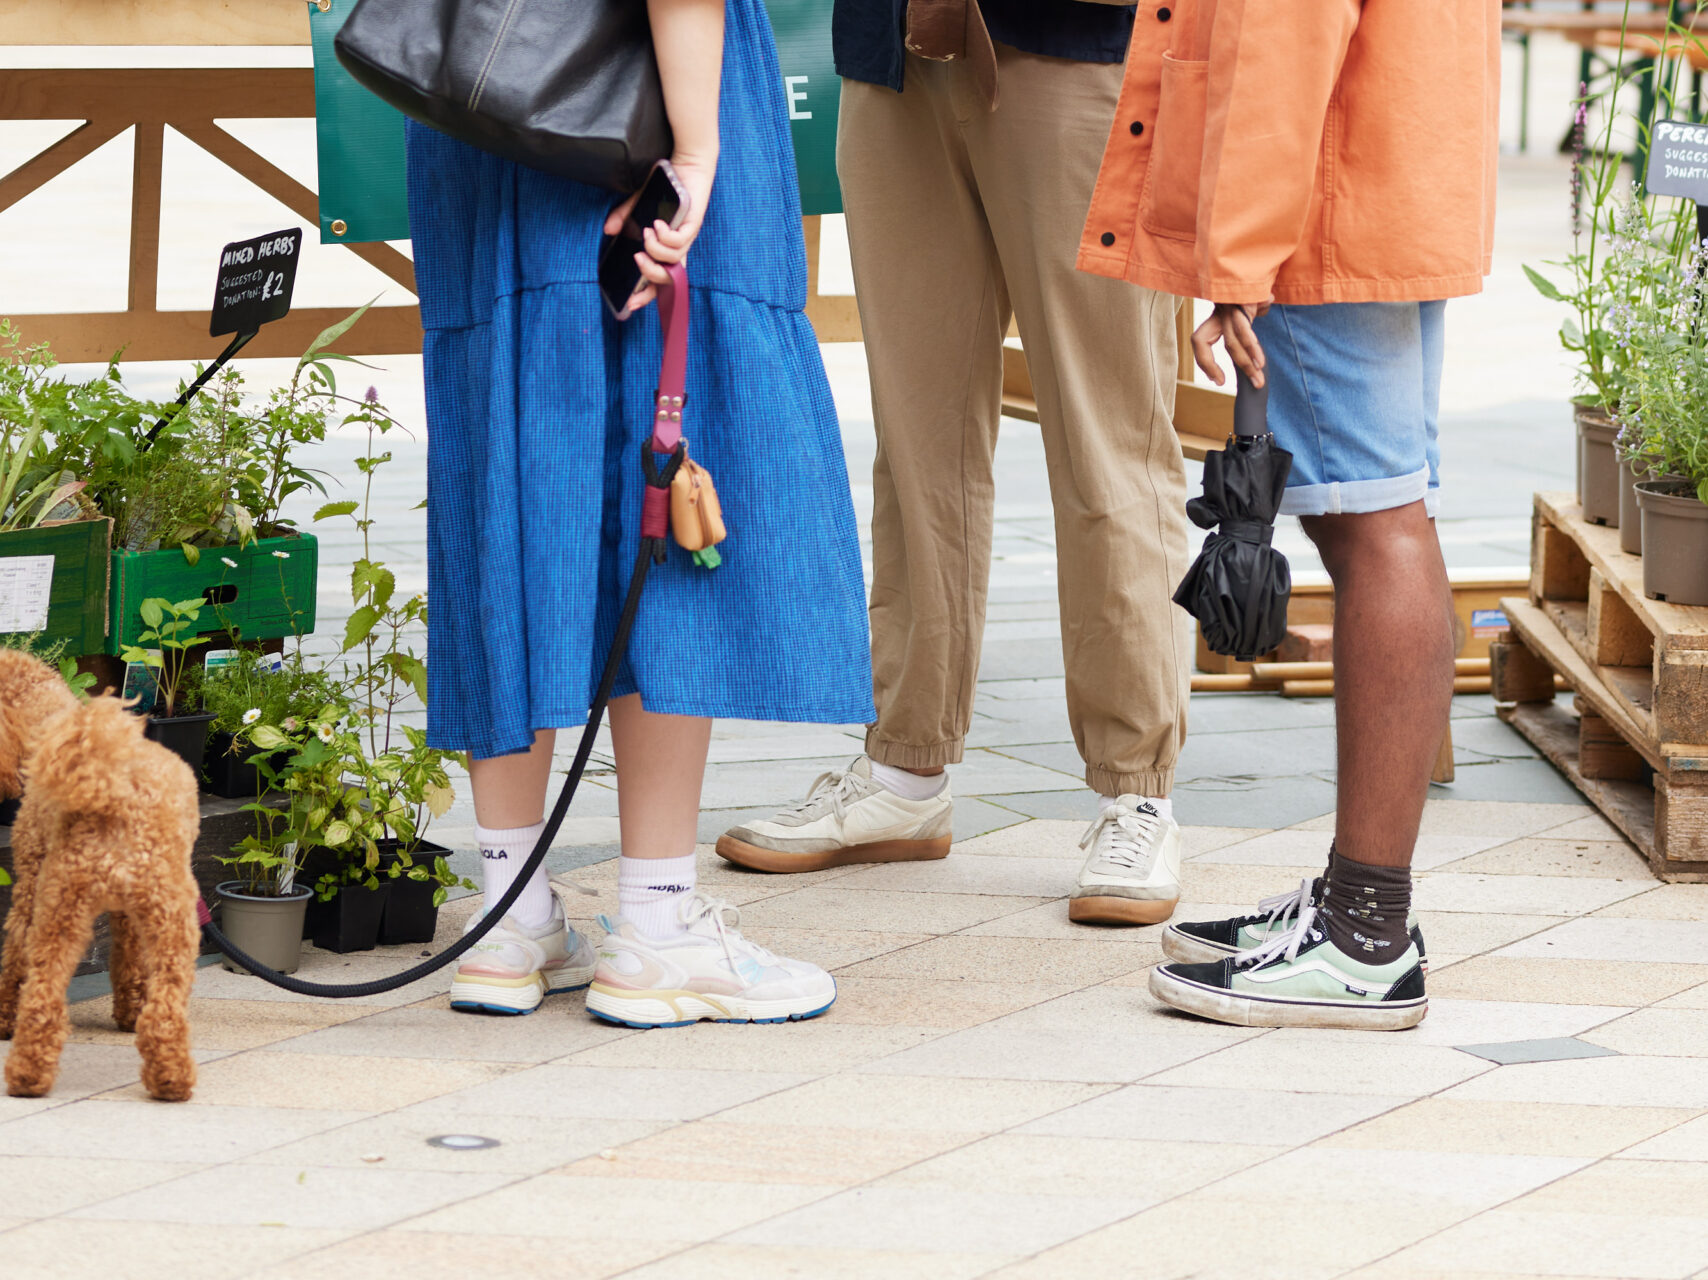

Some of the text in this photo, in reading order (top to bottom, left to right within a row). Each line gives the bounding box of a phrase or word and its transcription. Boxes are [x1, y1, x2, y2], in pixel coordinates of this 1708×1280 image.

[1664, 164, 1708, 179] DONATI
[221, 235, 296, 268] MIXED HERBS
[221, 269, 263, 290] SUGGESTED
[261, 271, 284, 301] £2
[479, 848, 508, 859] OLA
